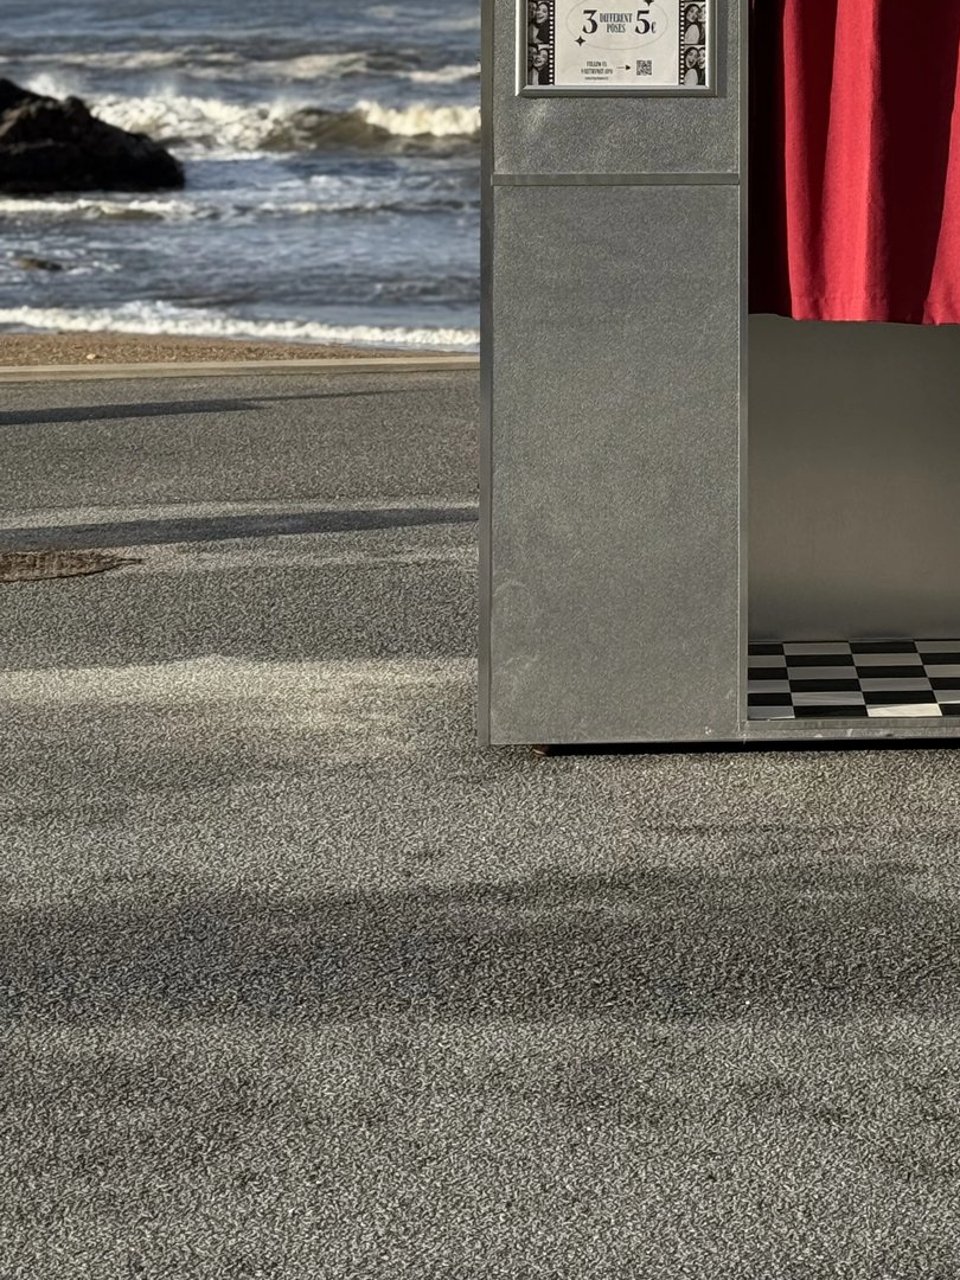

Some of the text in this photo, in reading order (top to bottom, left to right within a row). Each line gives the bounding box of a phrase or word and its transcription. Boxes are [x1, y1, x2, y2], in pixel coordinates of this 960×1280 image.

[582, 9, 598, 34] 3
[599, 13, 632, 23] DIFFERENT
[606, 24, 626, 33] POSES
